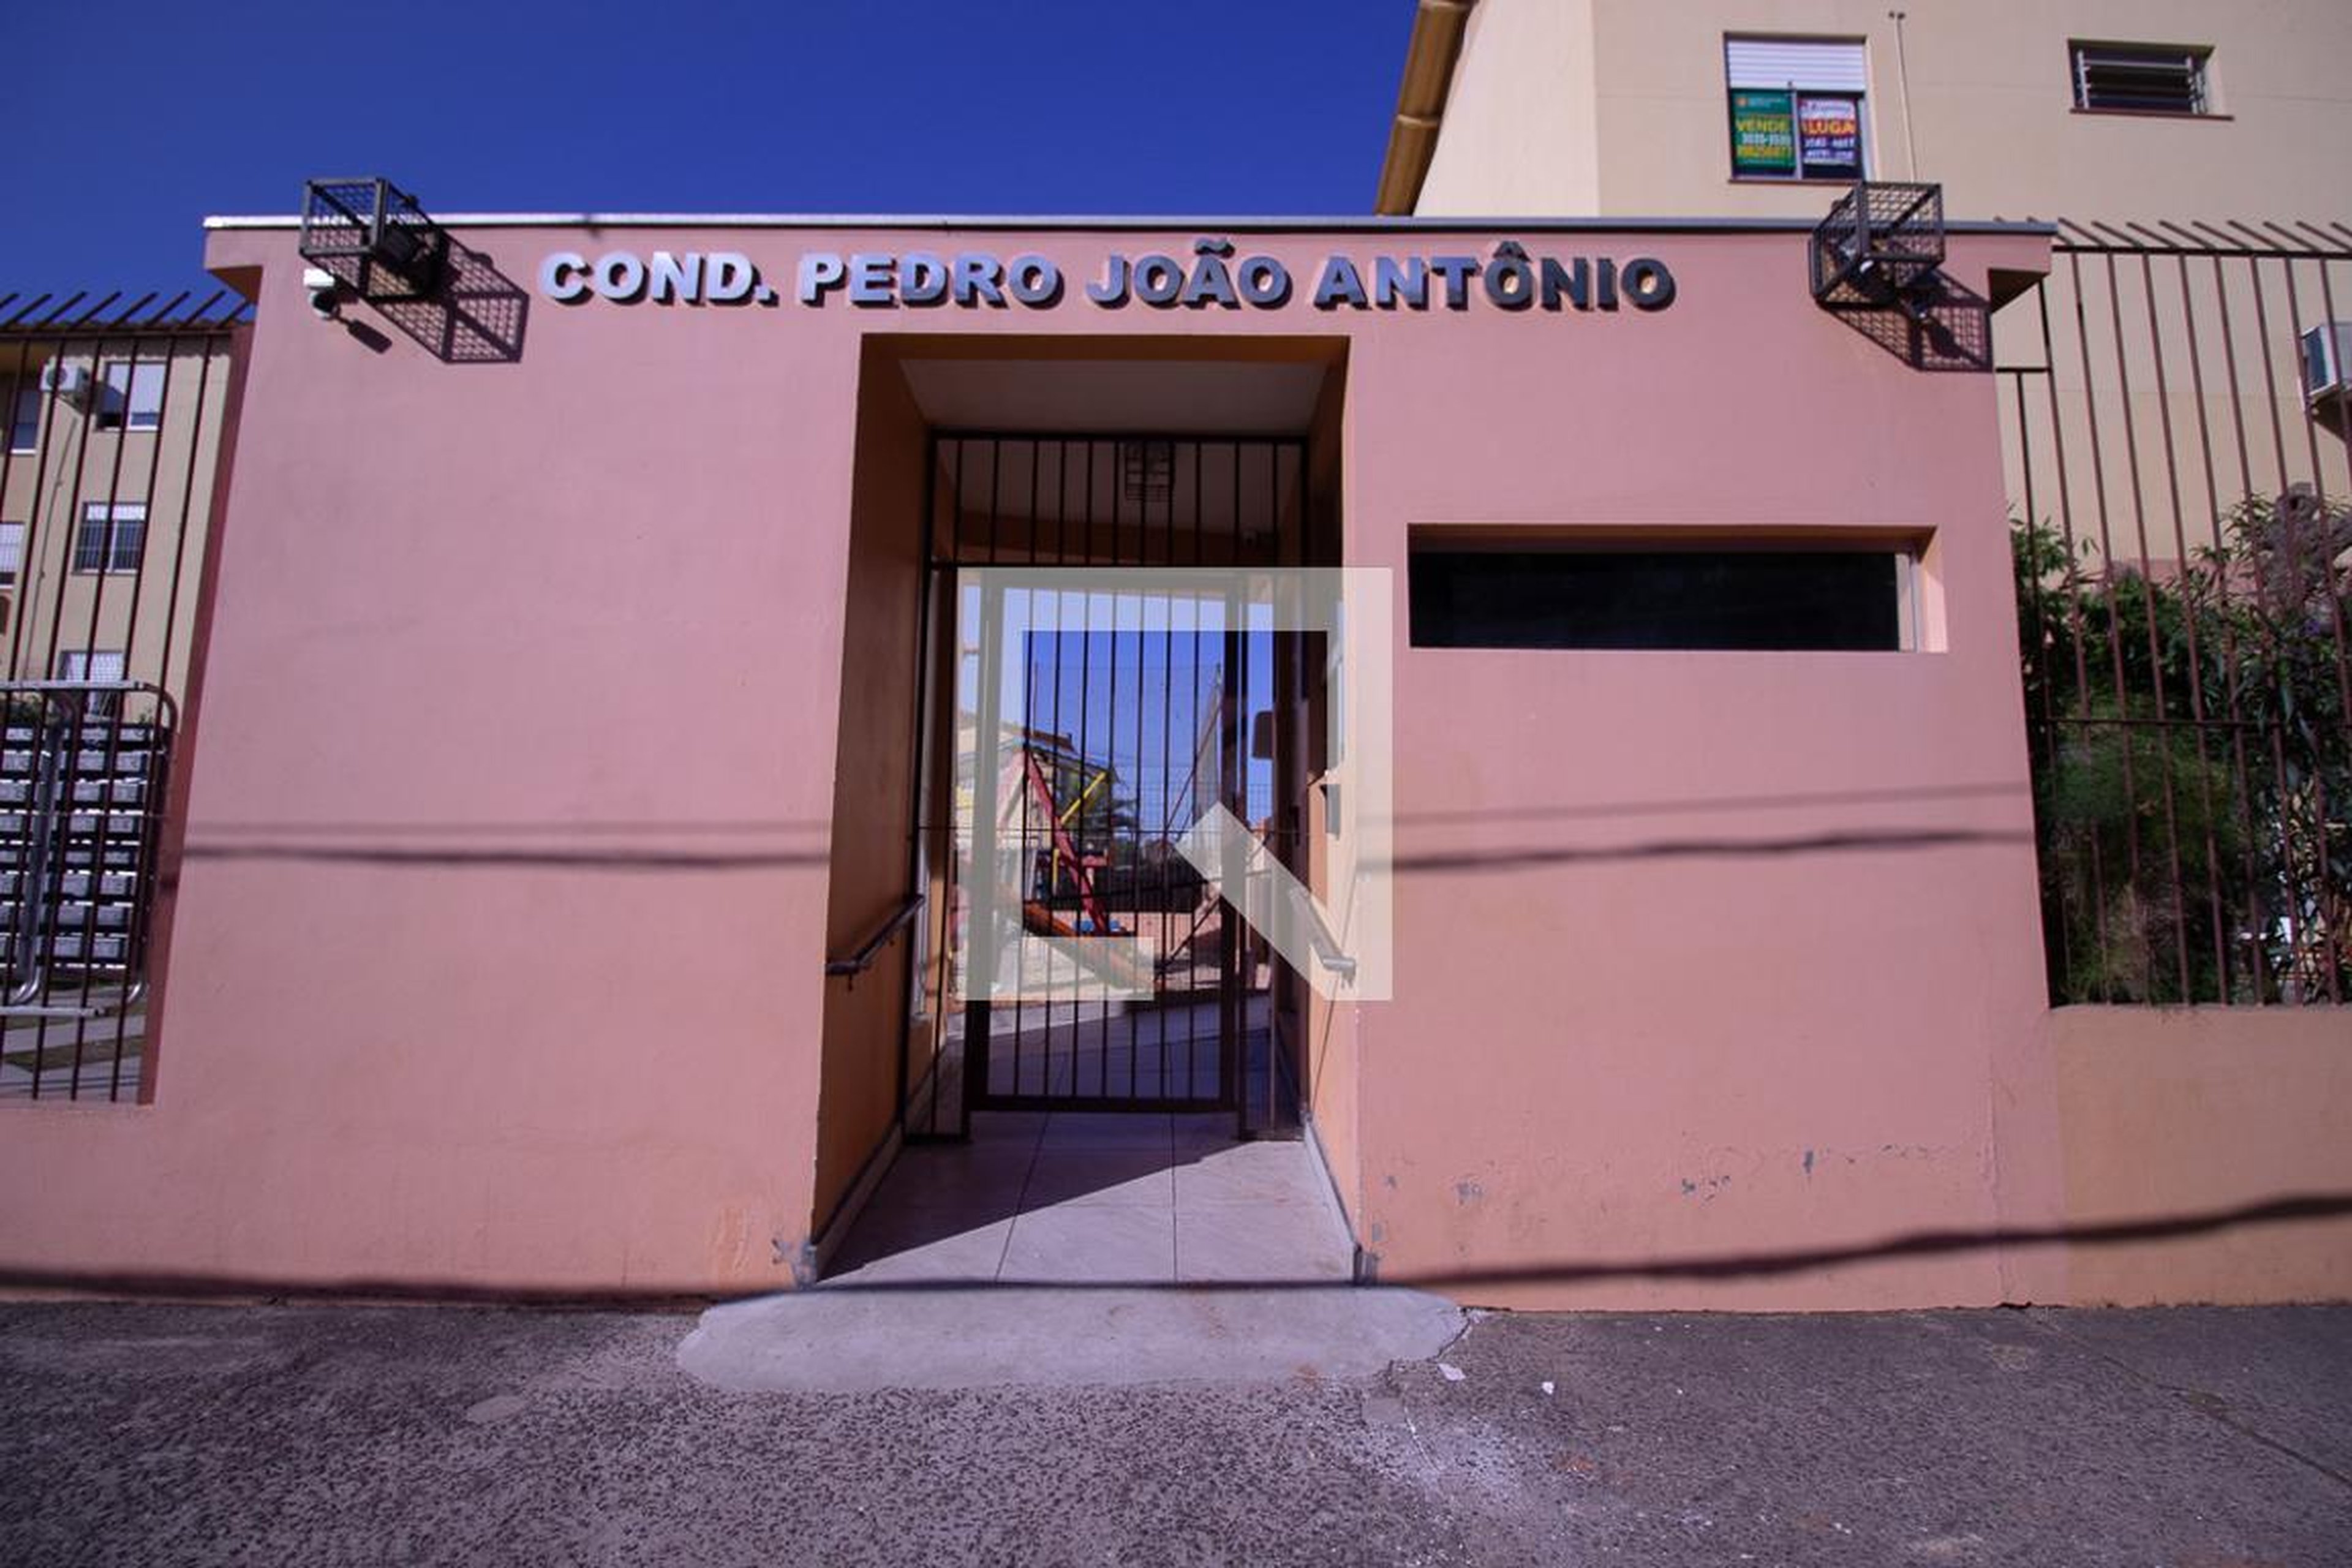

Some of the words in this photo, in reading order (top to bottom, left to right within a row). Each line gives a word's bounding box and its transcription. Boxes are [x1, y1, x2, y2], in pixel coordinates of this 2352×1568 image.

[1735, 118, 1790, 132] VENDE
[540, 251, 776, 306] COND.
[799, 252, 1063, 309] PEDRO
[1086, 236, 1292, 309] JOÃO
[1313, 240, 1675, 312] ANTÔNIO
